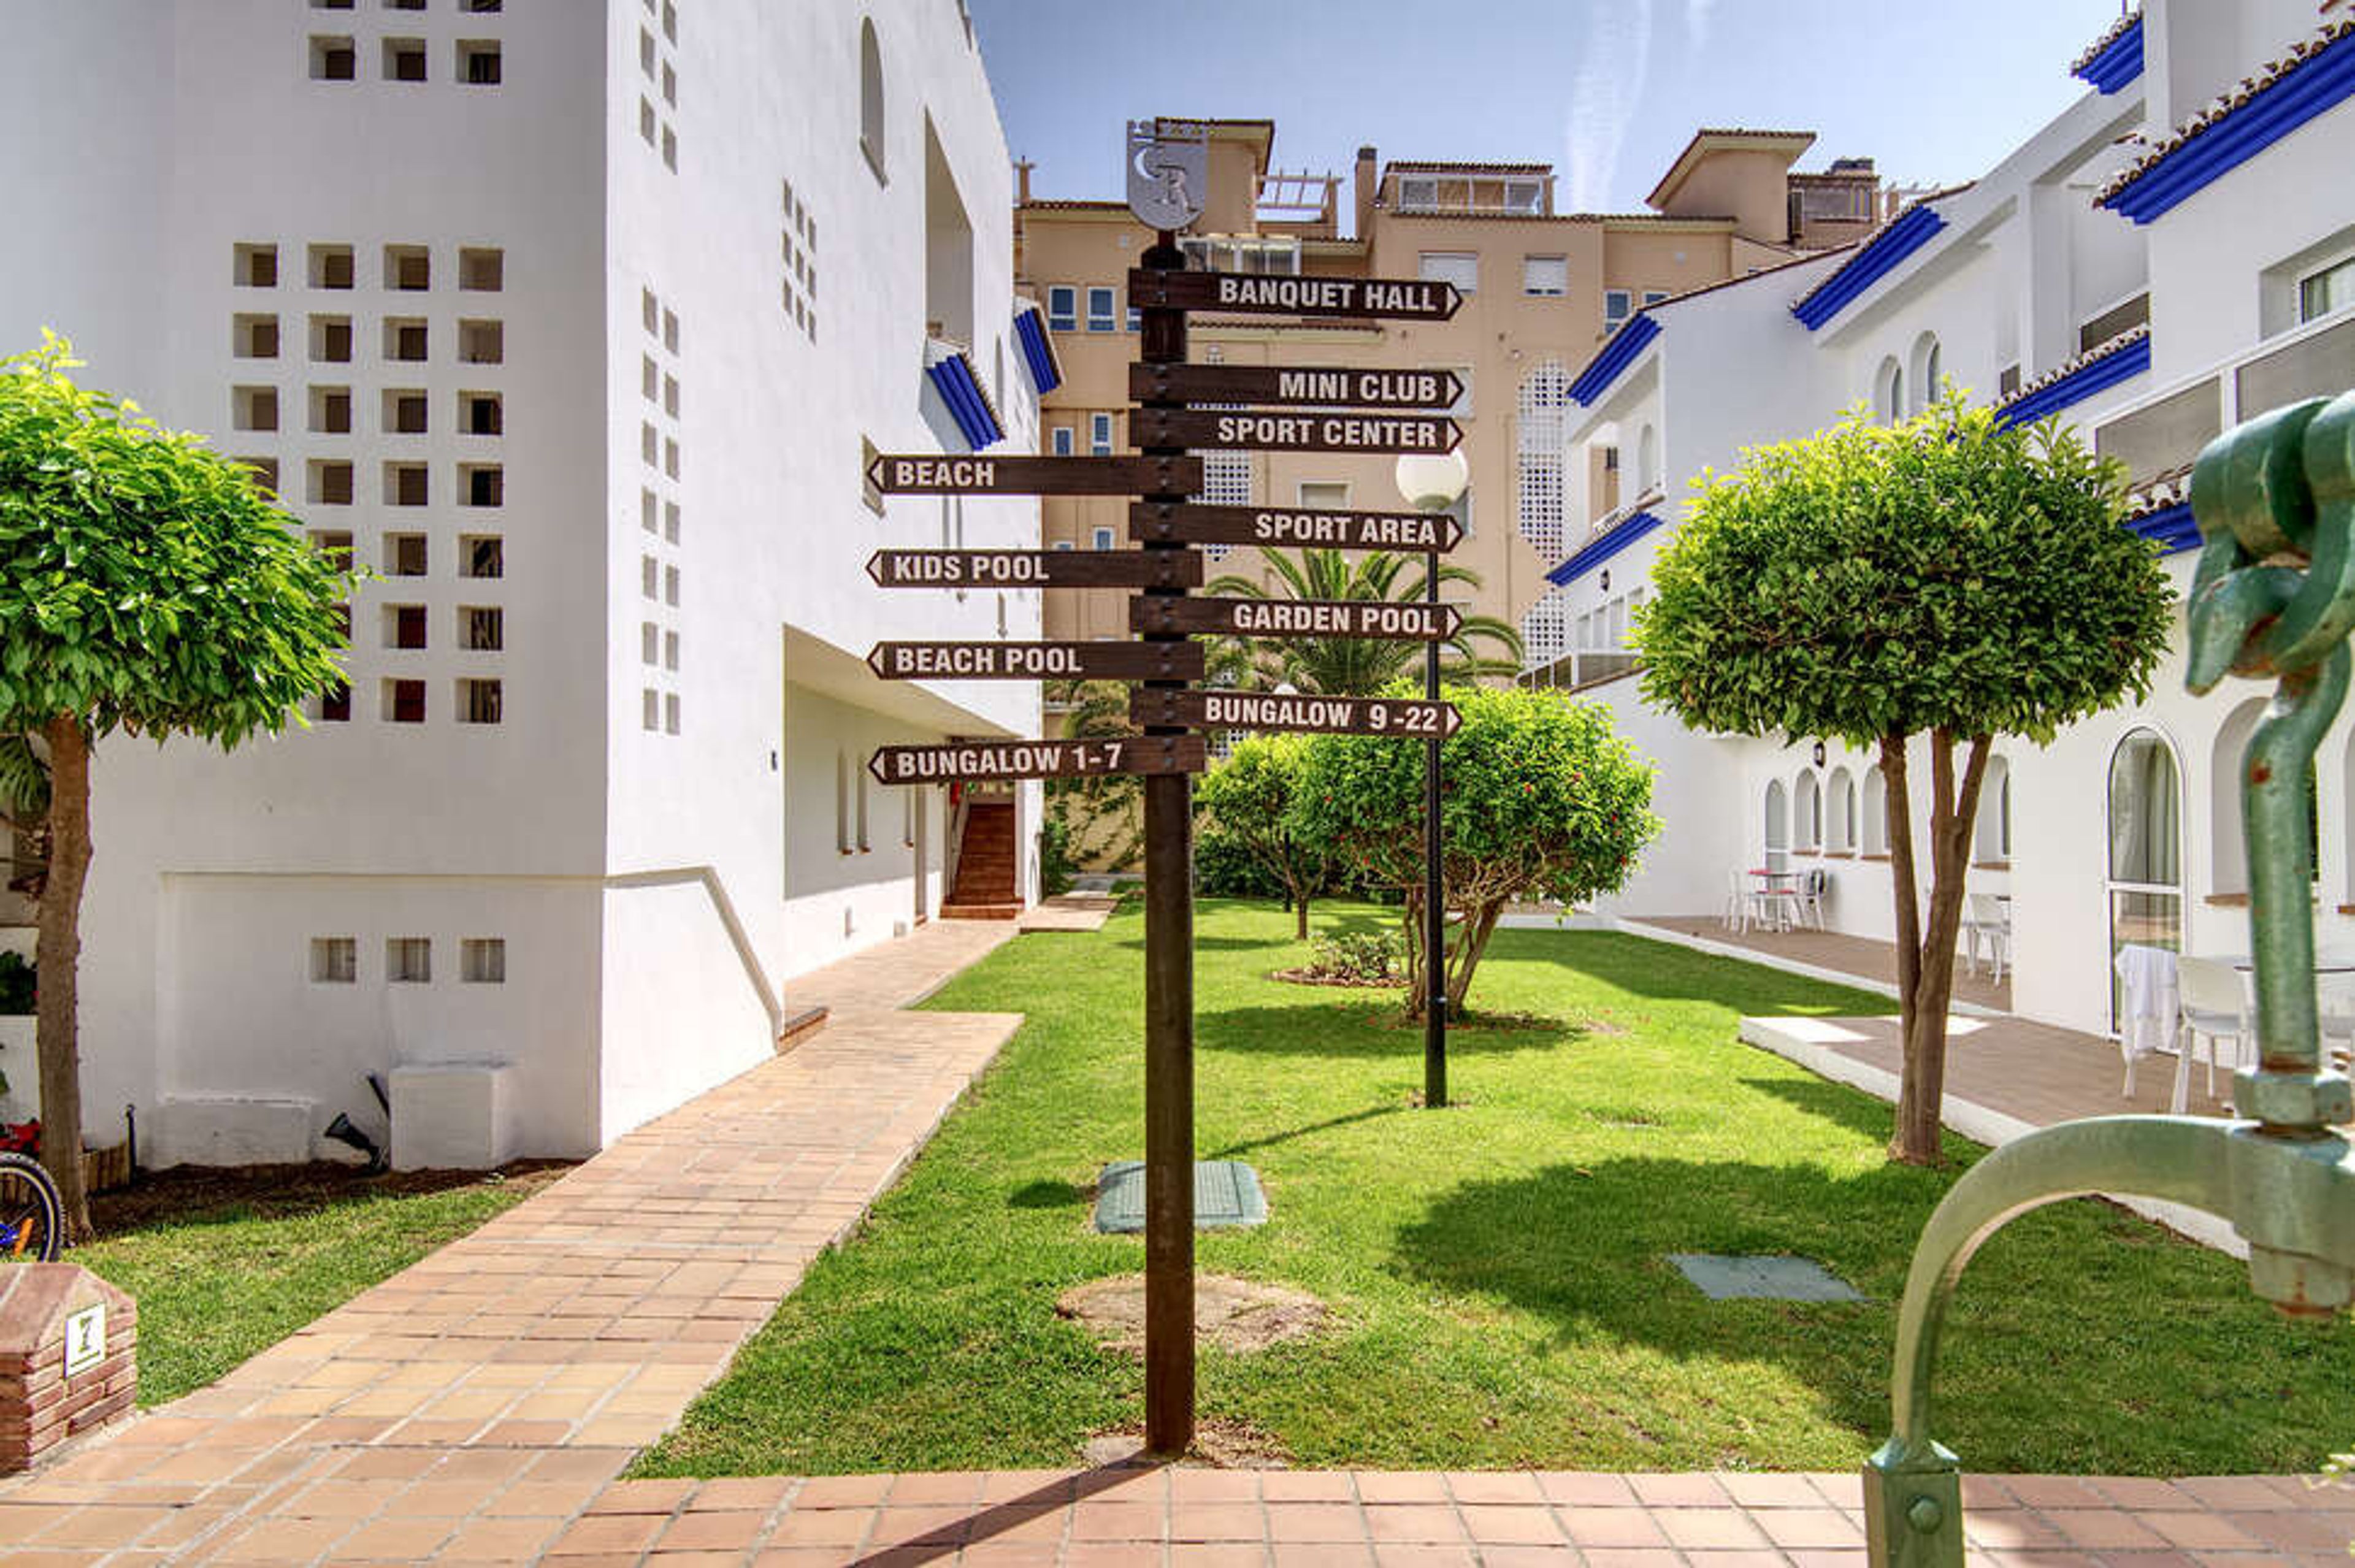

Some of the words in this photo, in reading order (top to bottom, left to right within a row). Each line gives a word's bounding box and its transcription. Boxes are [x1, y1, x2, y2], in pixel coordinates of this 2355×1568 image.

[1220, 278, 1354, 310] BANQUET
[1366, 285, 1436, 312] HALL
[1279, 372, 1348, 400] MINI
[1359, 374, 1436, 401] CLUB
[1219, 417, 1314, 444] SPORT
[1323, 420, 1436, 447] CENTER
[895, 461, 994, 486] BEACH
[1255, 513, 1352, 541] SPORT
[1360, 518, 1436, 545] AREA
[894, 555, 962, 581] KIDS
[972, 555, 1050, 581] POOL
[1234, 603, 1350, 632] GARDEN
[1361, 608, 1438, 634] POOL
[895, 647, 994, 673] BEACH
[1005, 647, 1084, 673] POOL
[1205, 696, 1352, 727] BUNGALOW
[897, 748, 1062, 778] BUNGALOW
